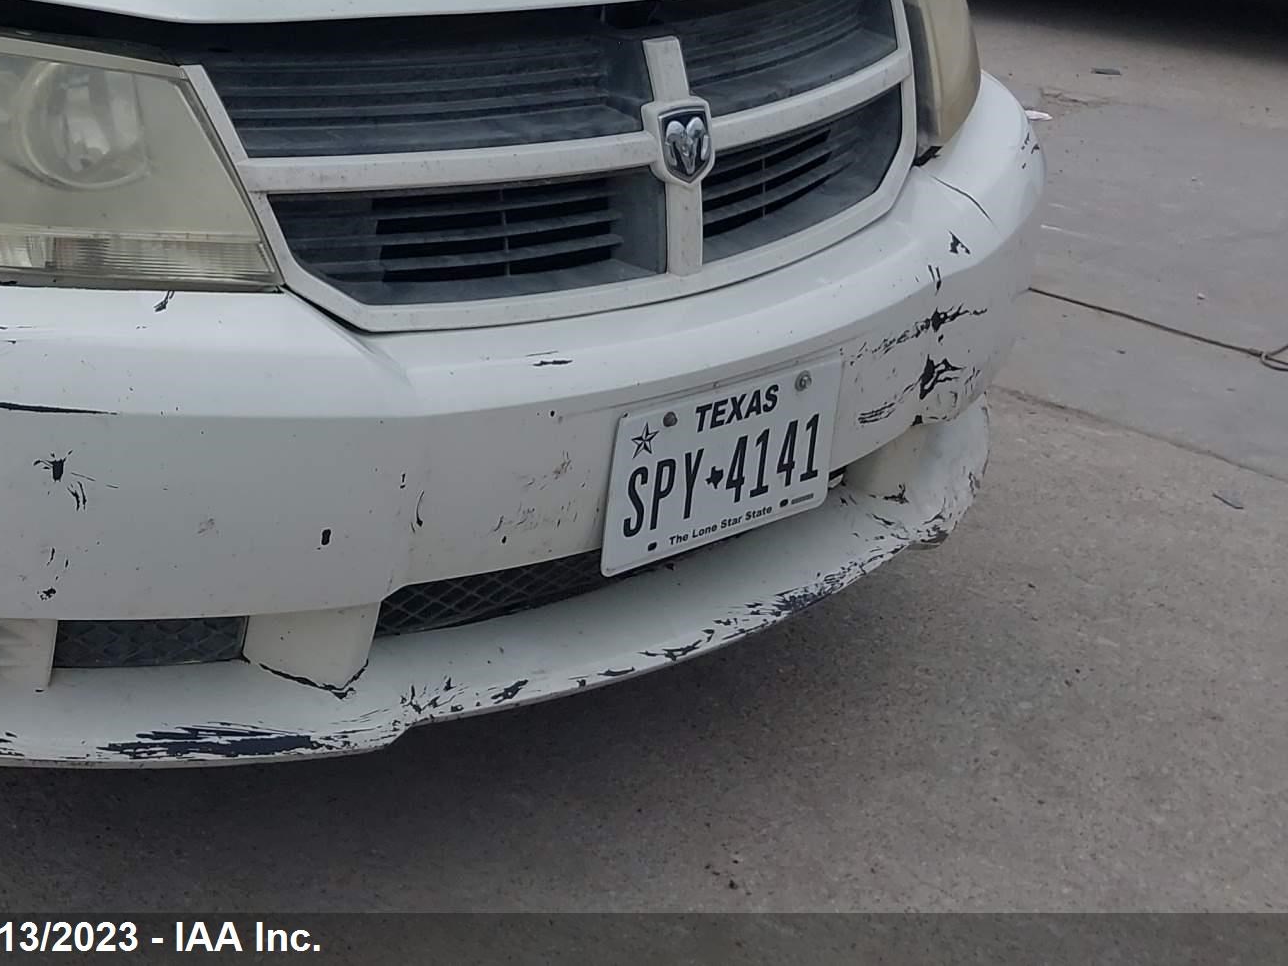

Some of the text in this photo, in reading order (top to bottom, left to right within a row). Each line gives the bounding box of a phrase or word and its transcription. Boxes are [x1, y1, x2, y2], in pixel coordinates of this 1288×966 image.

[695, 384, 780, 433] TEXAS
[623, 413, 820, 538] SPY 4141
[669, 506, 772, 546] The Lone Star State
